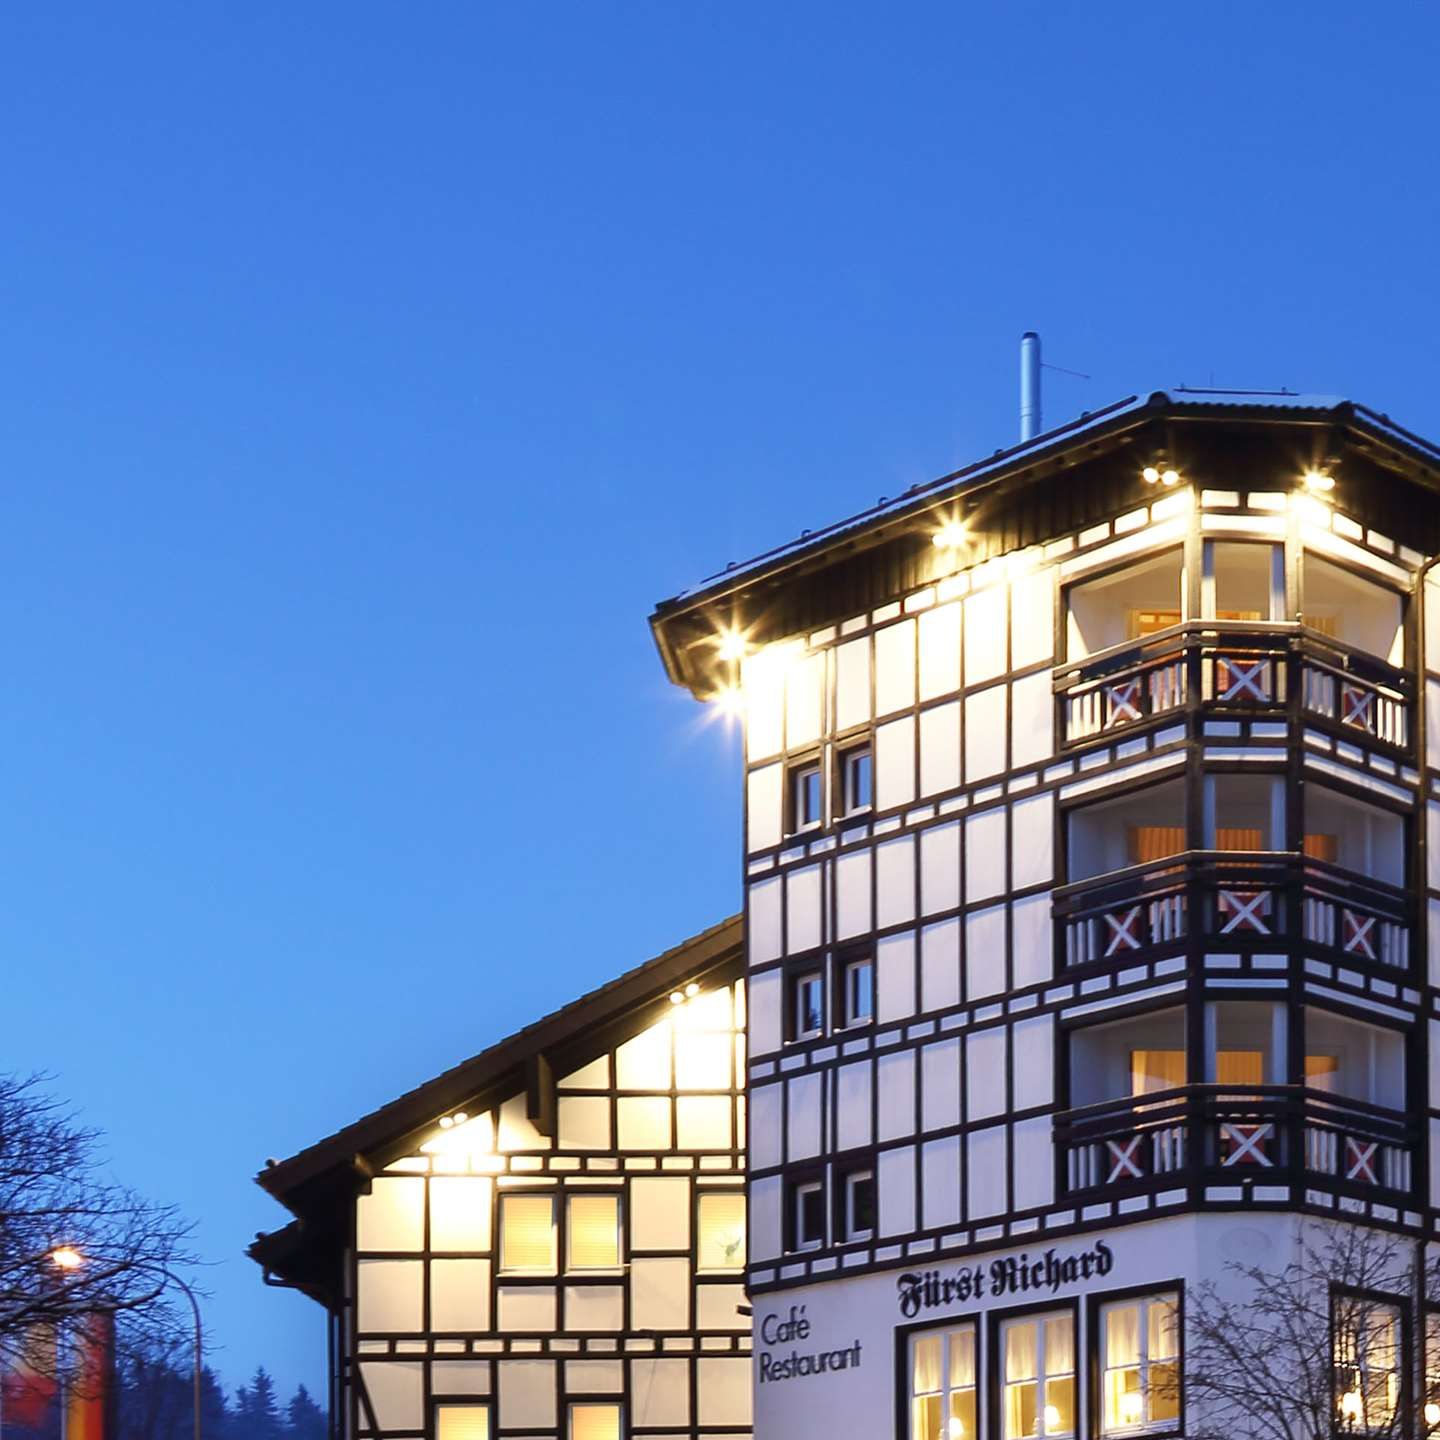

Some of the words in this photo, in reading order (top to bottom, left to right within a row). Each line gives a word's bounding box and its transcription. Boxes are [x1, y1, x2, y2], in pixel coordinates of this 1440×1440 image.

[896, 1264, 984, 1318] Fürst
[989, 1239, 1114, 1298] Richard
[761, 1305, 810, 1346] Café
[759, 1339, 863, 1384] Restaurant
